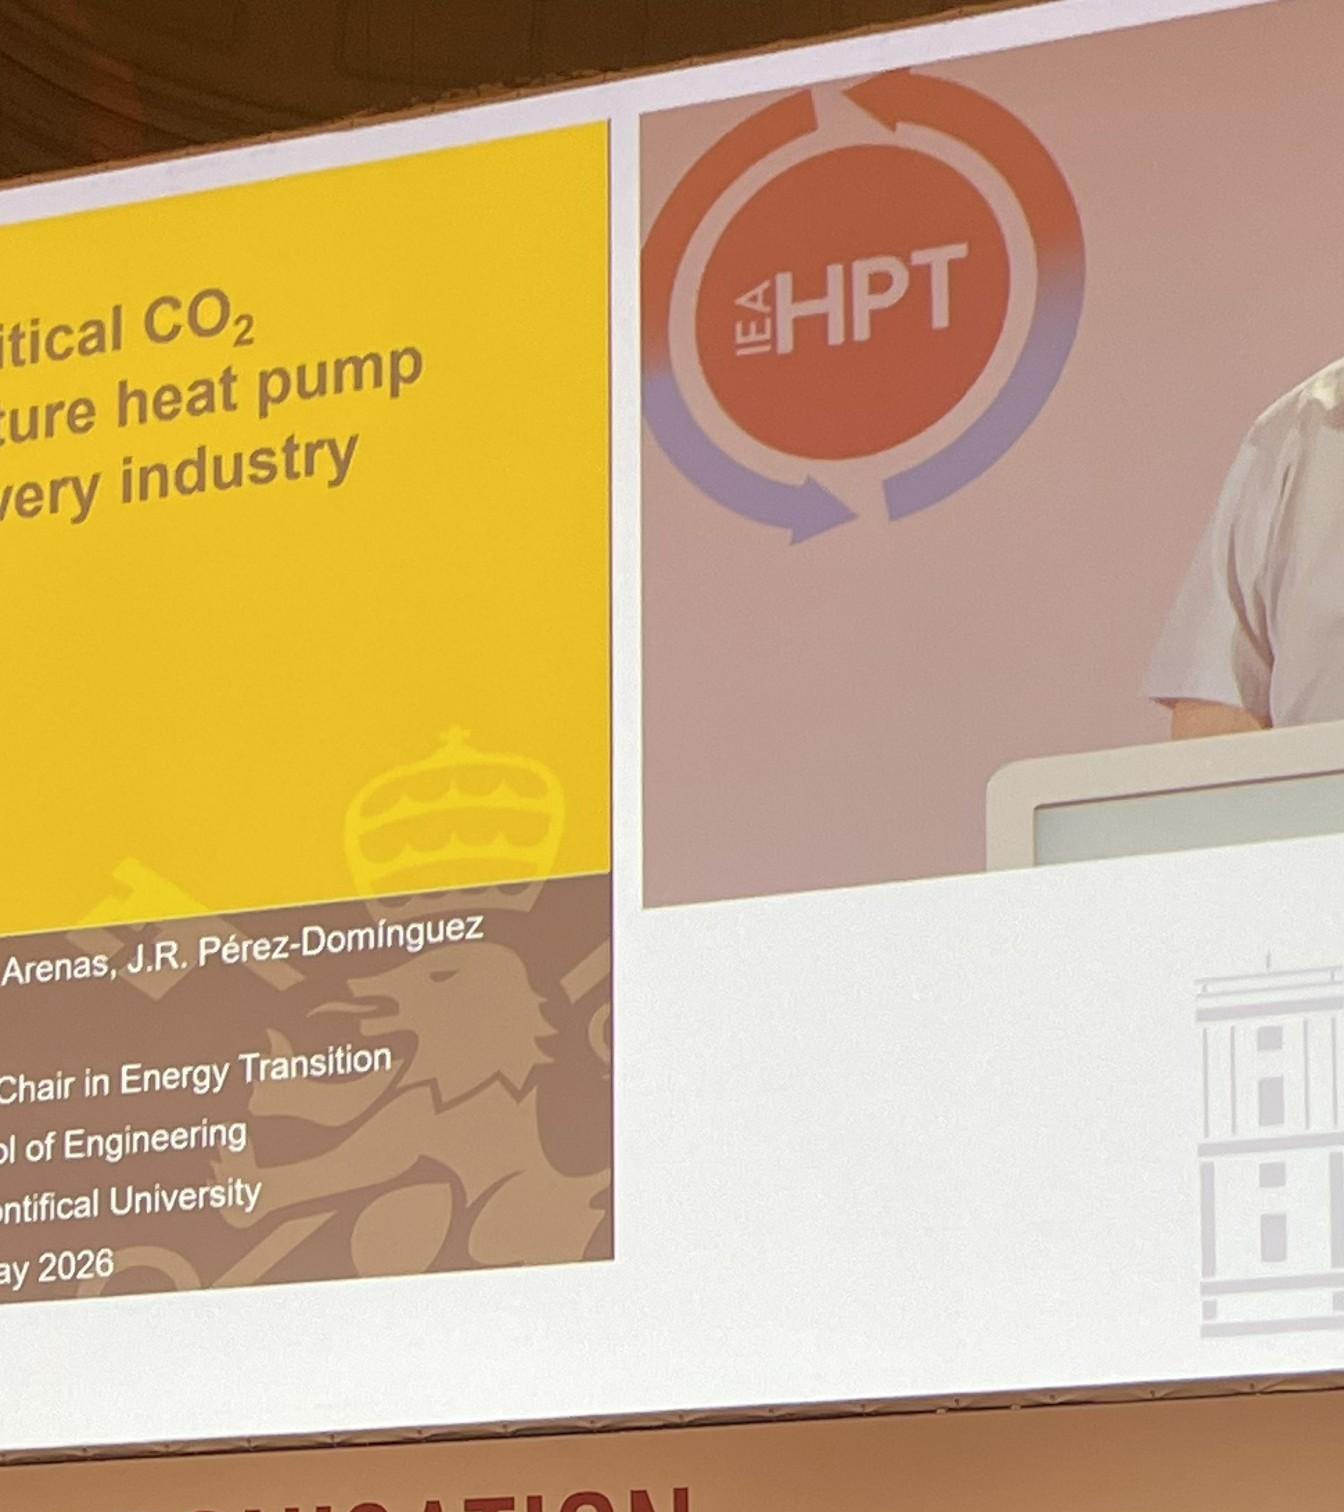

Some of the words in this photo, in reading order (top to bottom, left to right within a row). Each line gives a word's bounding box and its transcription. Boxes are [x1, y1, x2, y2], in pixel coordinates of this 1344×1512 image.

[734, 278, 772, 357] IEA
[775, 242, 968, 355] HPT
[118, 365, 238, 427] heat
[258, 346, 423, 419] pump
[121, 433, 359, 504] industry
[1, 954, 117, 987] Arenas,
[127, 941, 187, 973] J.R.
[199, 914, 485, 967] Pérez-Domínguez
[84, 1067, 109, 1097] in
[120, 1062, 230, 1095] Energy
[239, 1044, 392, 1084] Transition
[25, 1131, 55, 1162] of
[64, 1119, 247, 1164] Engineering
[110, 1178, 262, 1217] University
[38, 1248, 115, 1283] 2026
